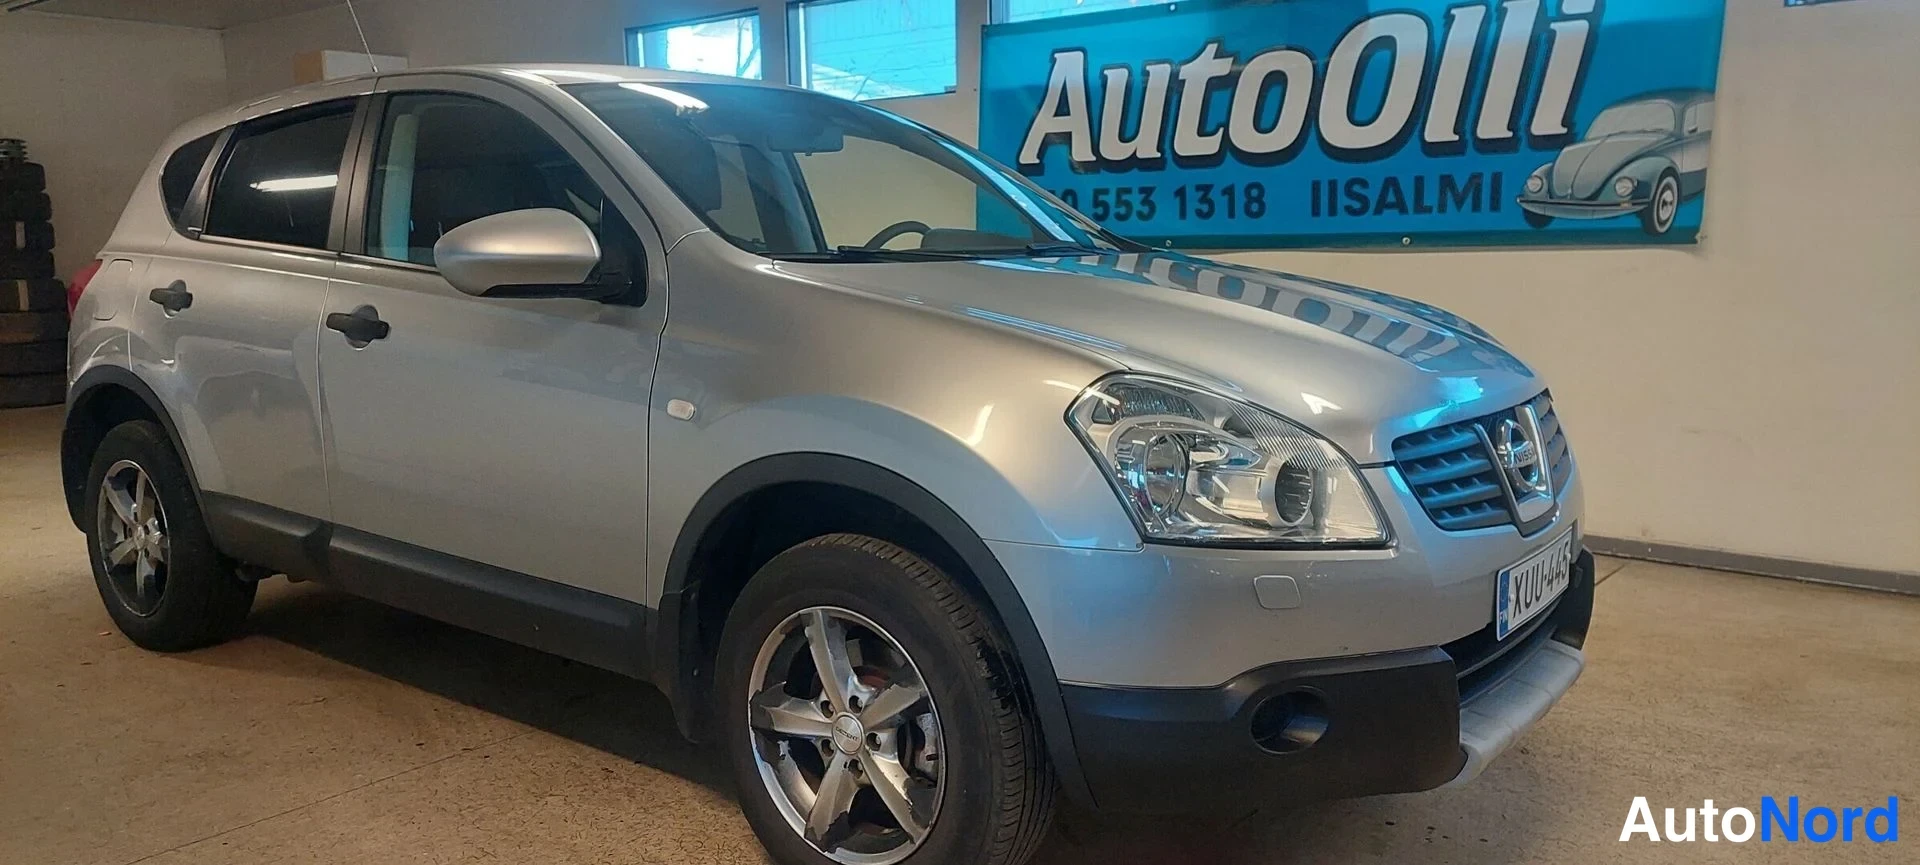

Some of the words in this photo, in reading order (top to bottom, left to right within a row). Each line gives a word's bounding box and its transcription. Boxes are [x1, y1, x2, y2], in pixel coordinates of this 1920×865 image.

[1017, 0, 1592, 168] AutoOlli
[1091, 186, 1157, 222] 553
[1173, 181, 1267, 221] 1318
[1310, 171, 1504, 218] IISALMI
[1512, 540, 1570, 620] XUU-445
